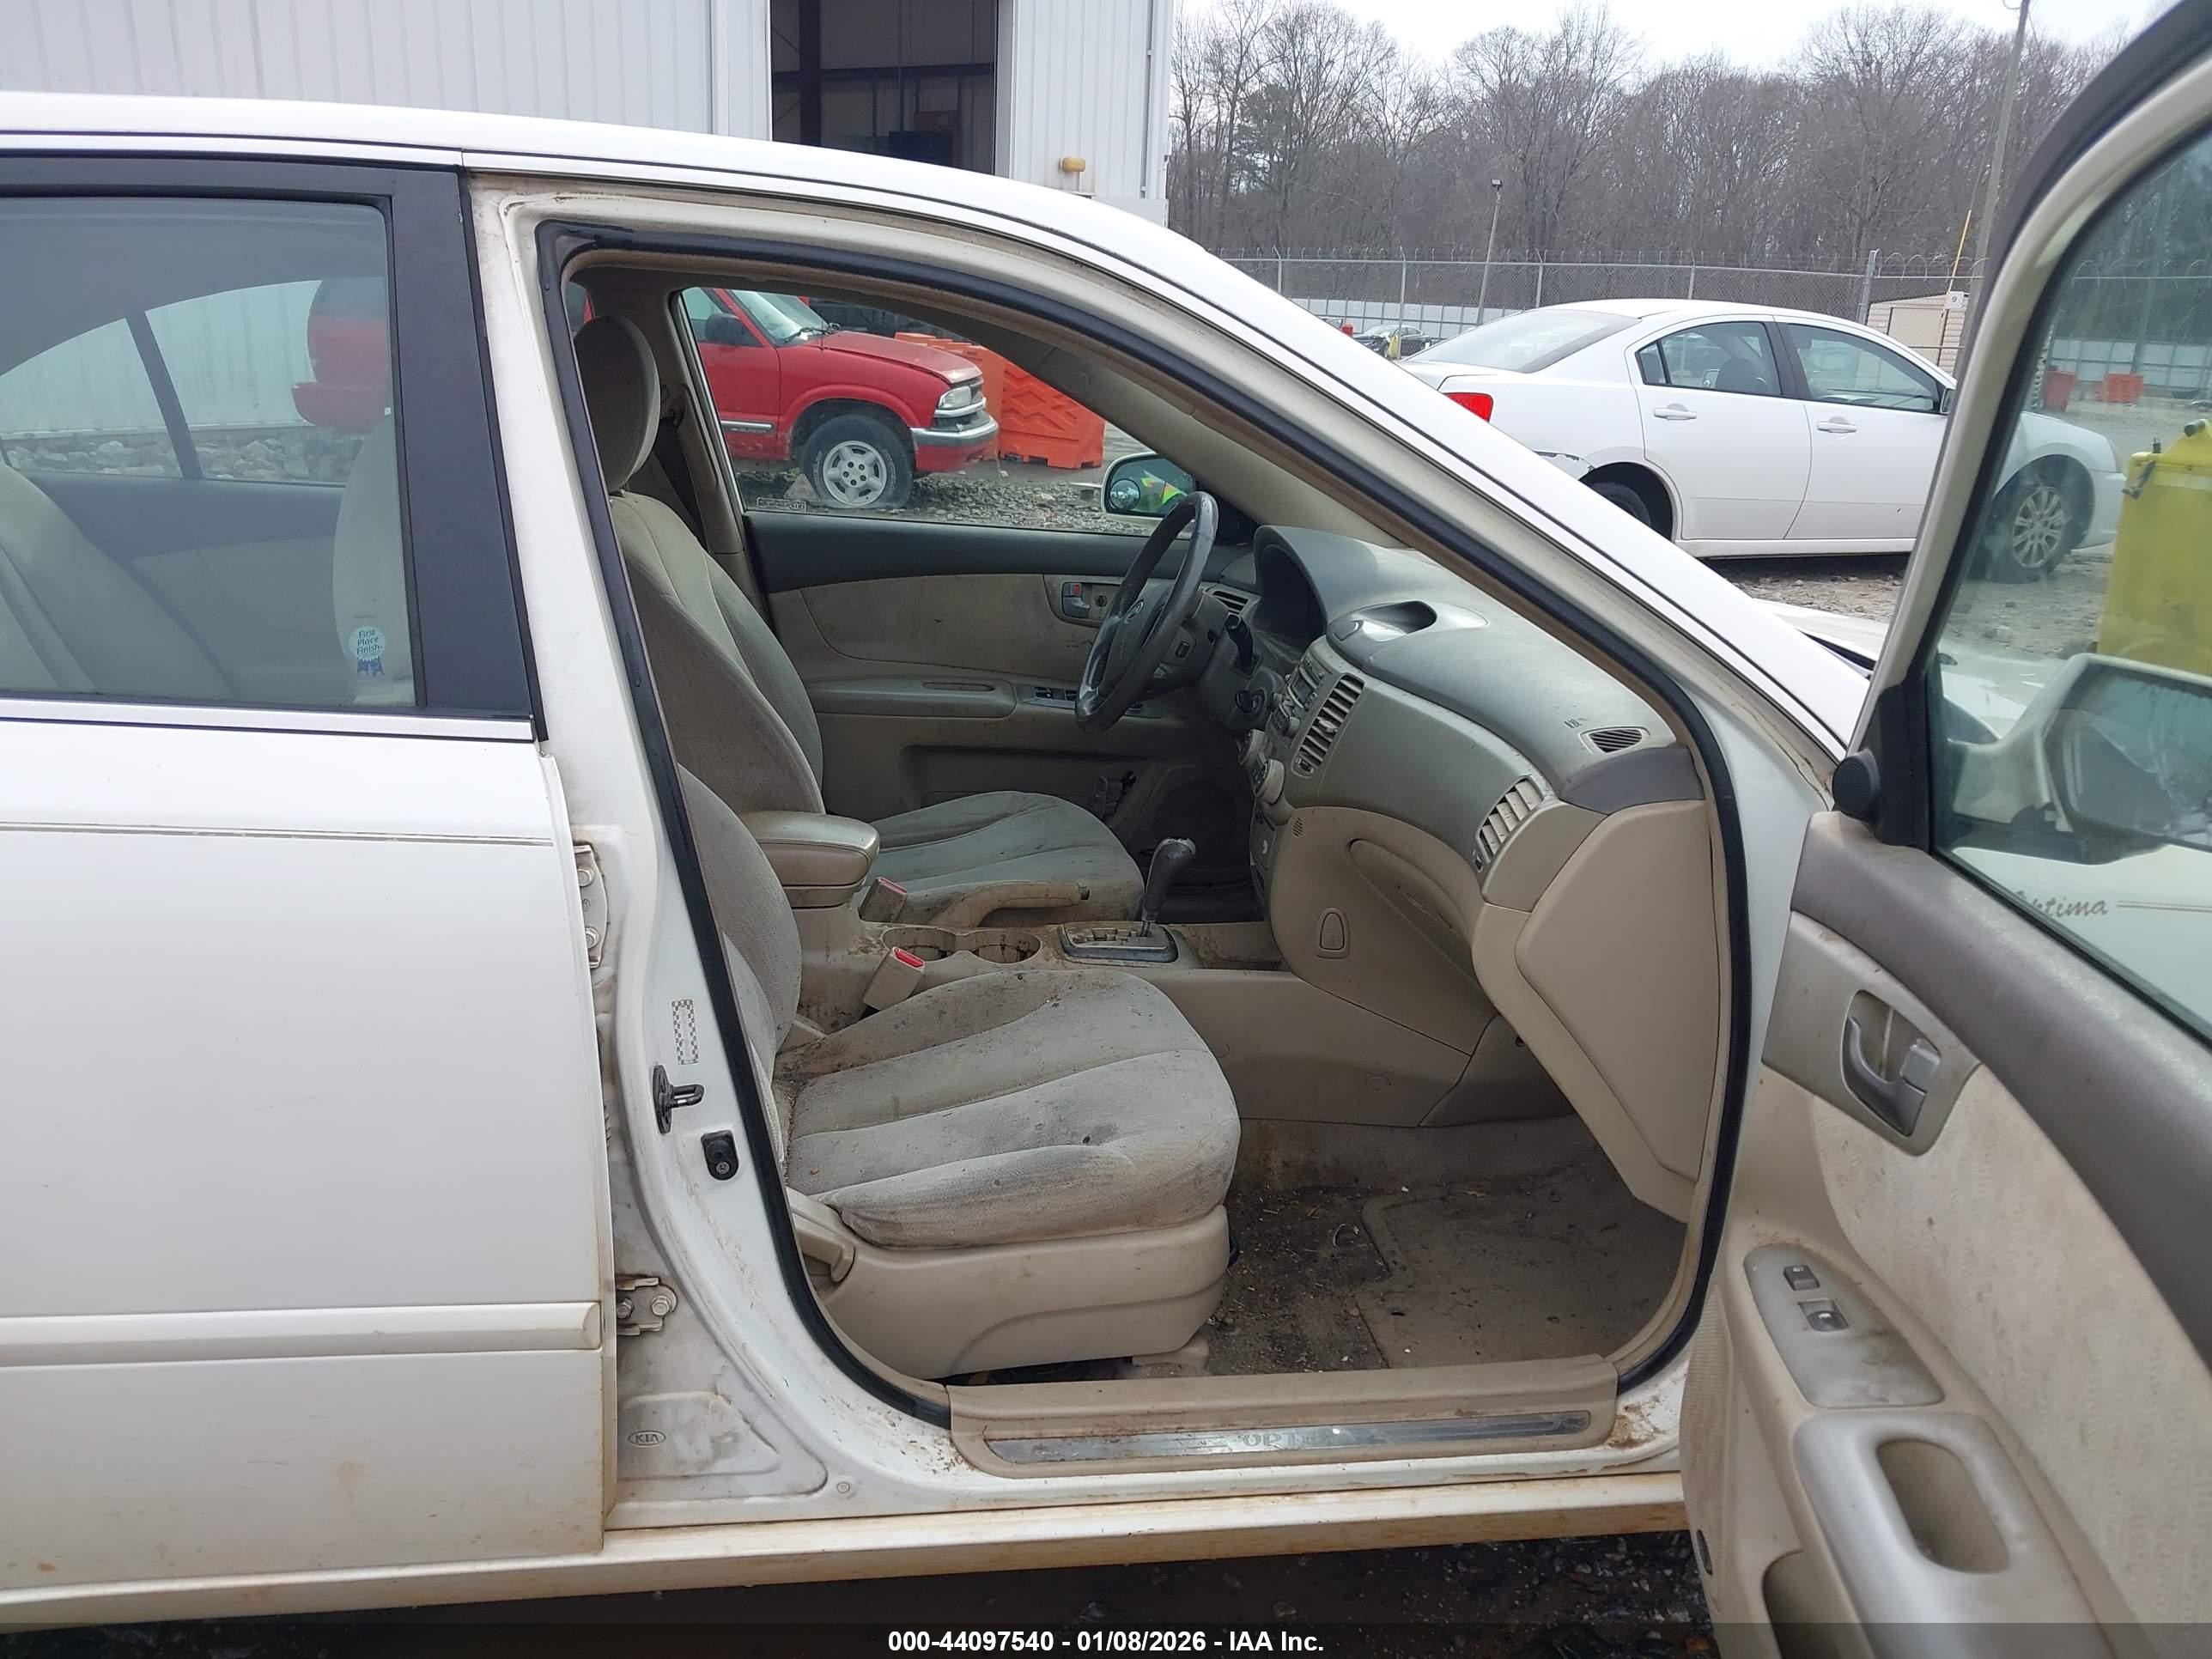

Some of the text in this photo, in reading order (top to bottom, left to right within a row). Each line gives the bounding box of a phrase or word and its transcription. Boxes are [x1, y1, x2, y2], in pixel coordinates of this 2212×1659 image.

[358, 629, 375, 638] First
[357, 636, 379, 647] Place
[356, 644, 380, 655] Finish
[2015, 890, 2109, 918] tima
[635, 1433, 659, 1443] KIA
